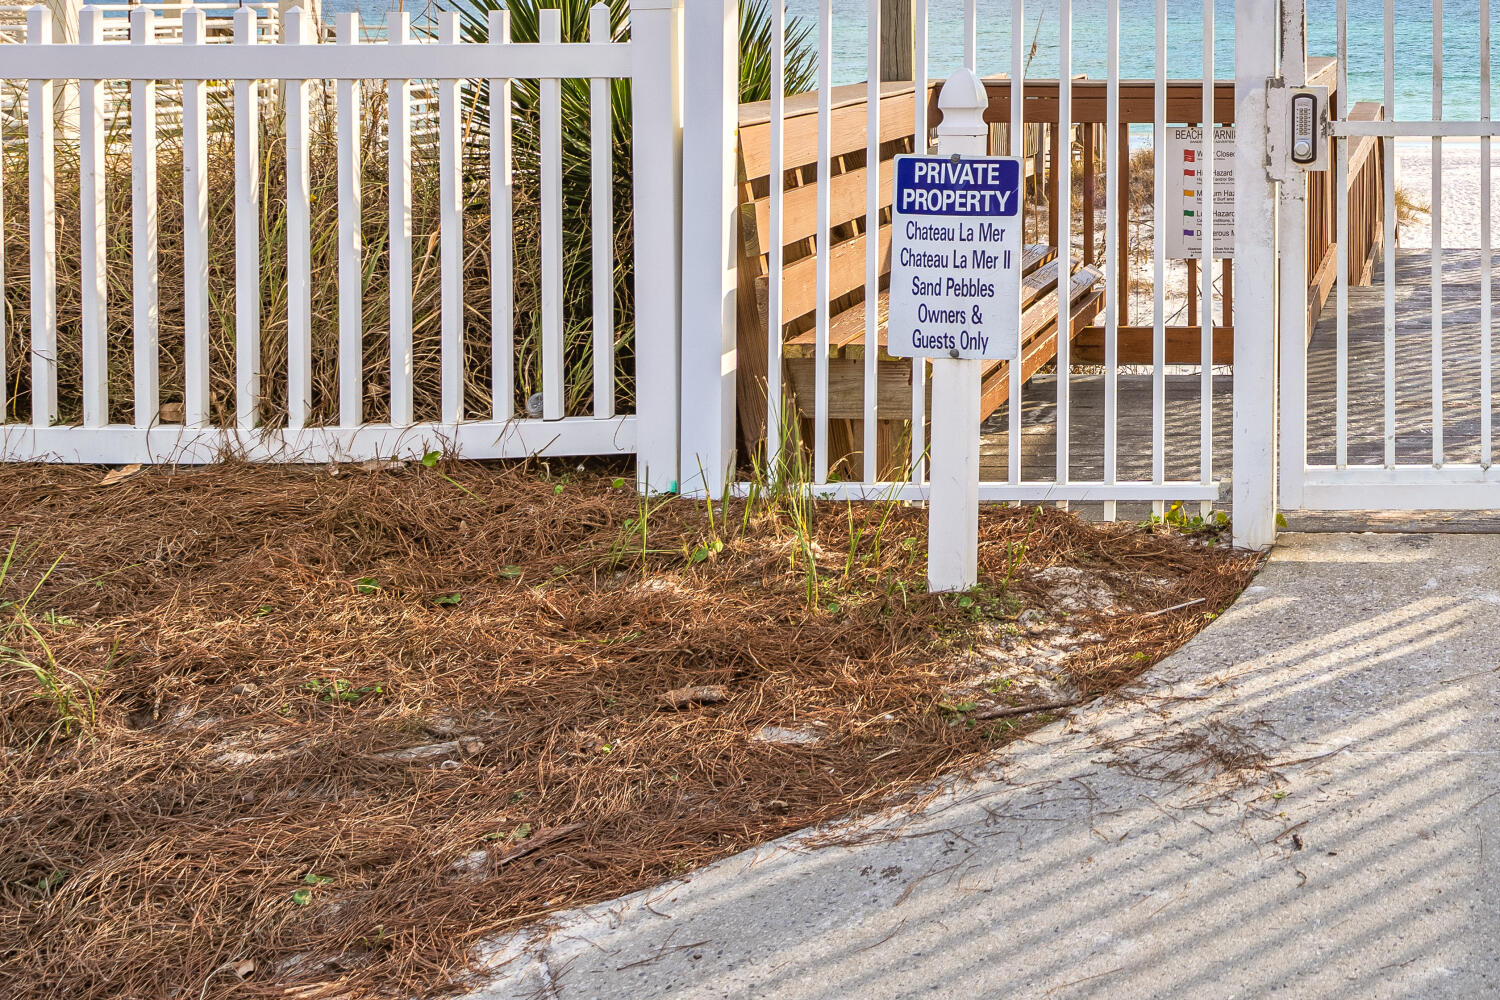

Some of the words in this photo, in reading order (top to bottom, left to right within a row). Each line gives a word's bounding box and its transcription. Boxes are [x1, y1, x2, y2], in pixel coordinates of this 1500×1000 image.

[1175, 129, 1203, 139] BEACH
[914, 162, 1000, 185] PRIVATE
[902, 188, 1011, 212] PROPERTY
[906, 221, 955, 242] Chateau
[959, 222, 974, 242] La
[979, 222, 1005, 243] Mer
[900, 247, 948, 268] Chateau
[953, 249, 967, 269] La
[972, 250, 998, 269] Mer
[1003, 250, 1011, 269] II
[911, 276, 941, 297] Sand
[946, 277, 995, 298] Pebbles
[918, 303, 966, 324] Owners
[971, 304, 983, 325] &
[912, 329, 956, 350] Guests
[960, 330, 989, 355] Only
